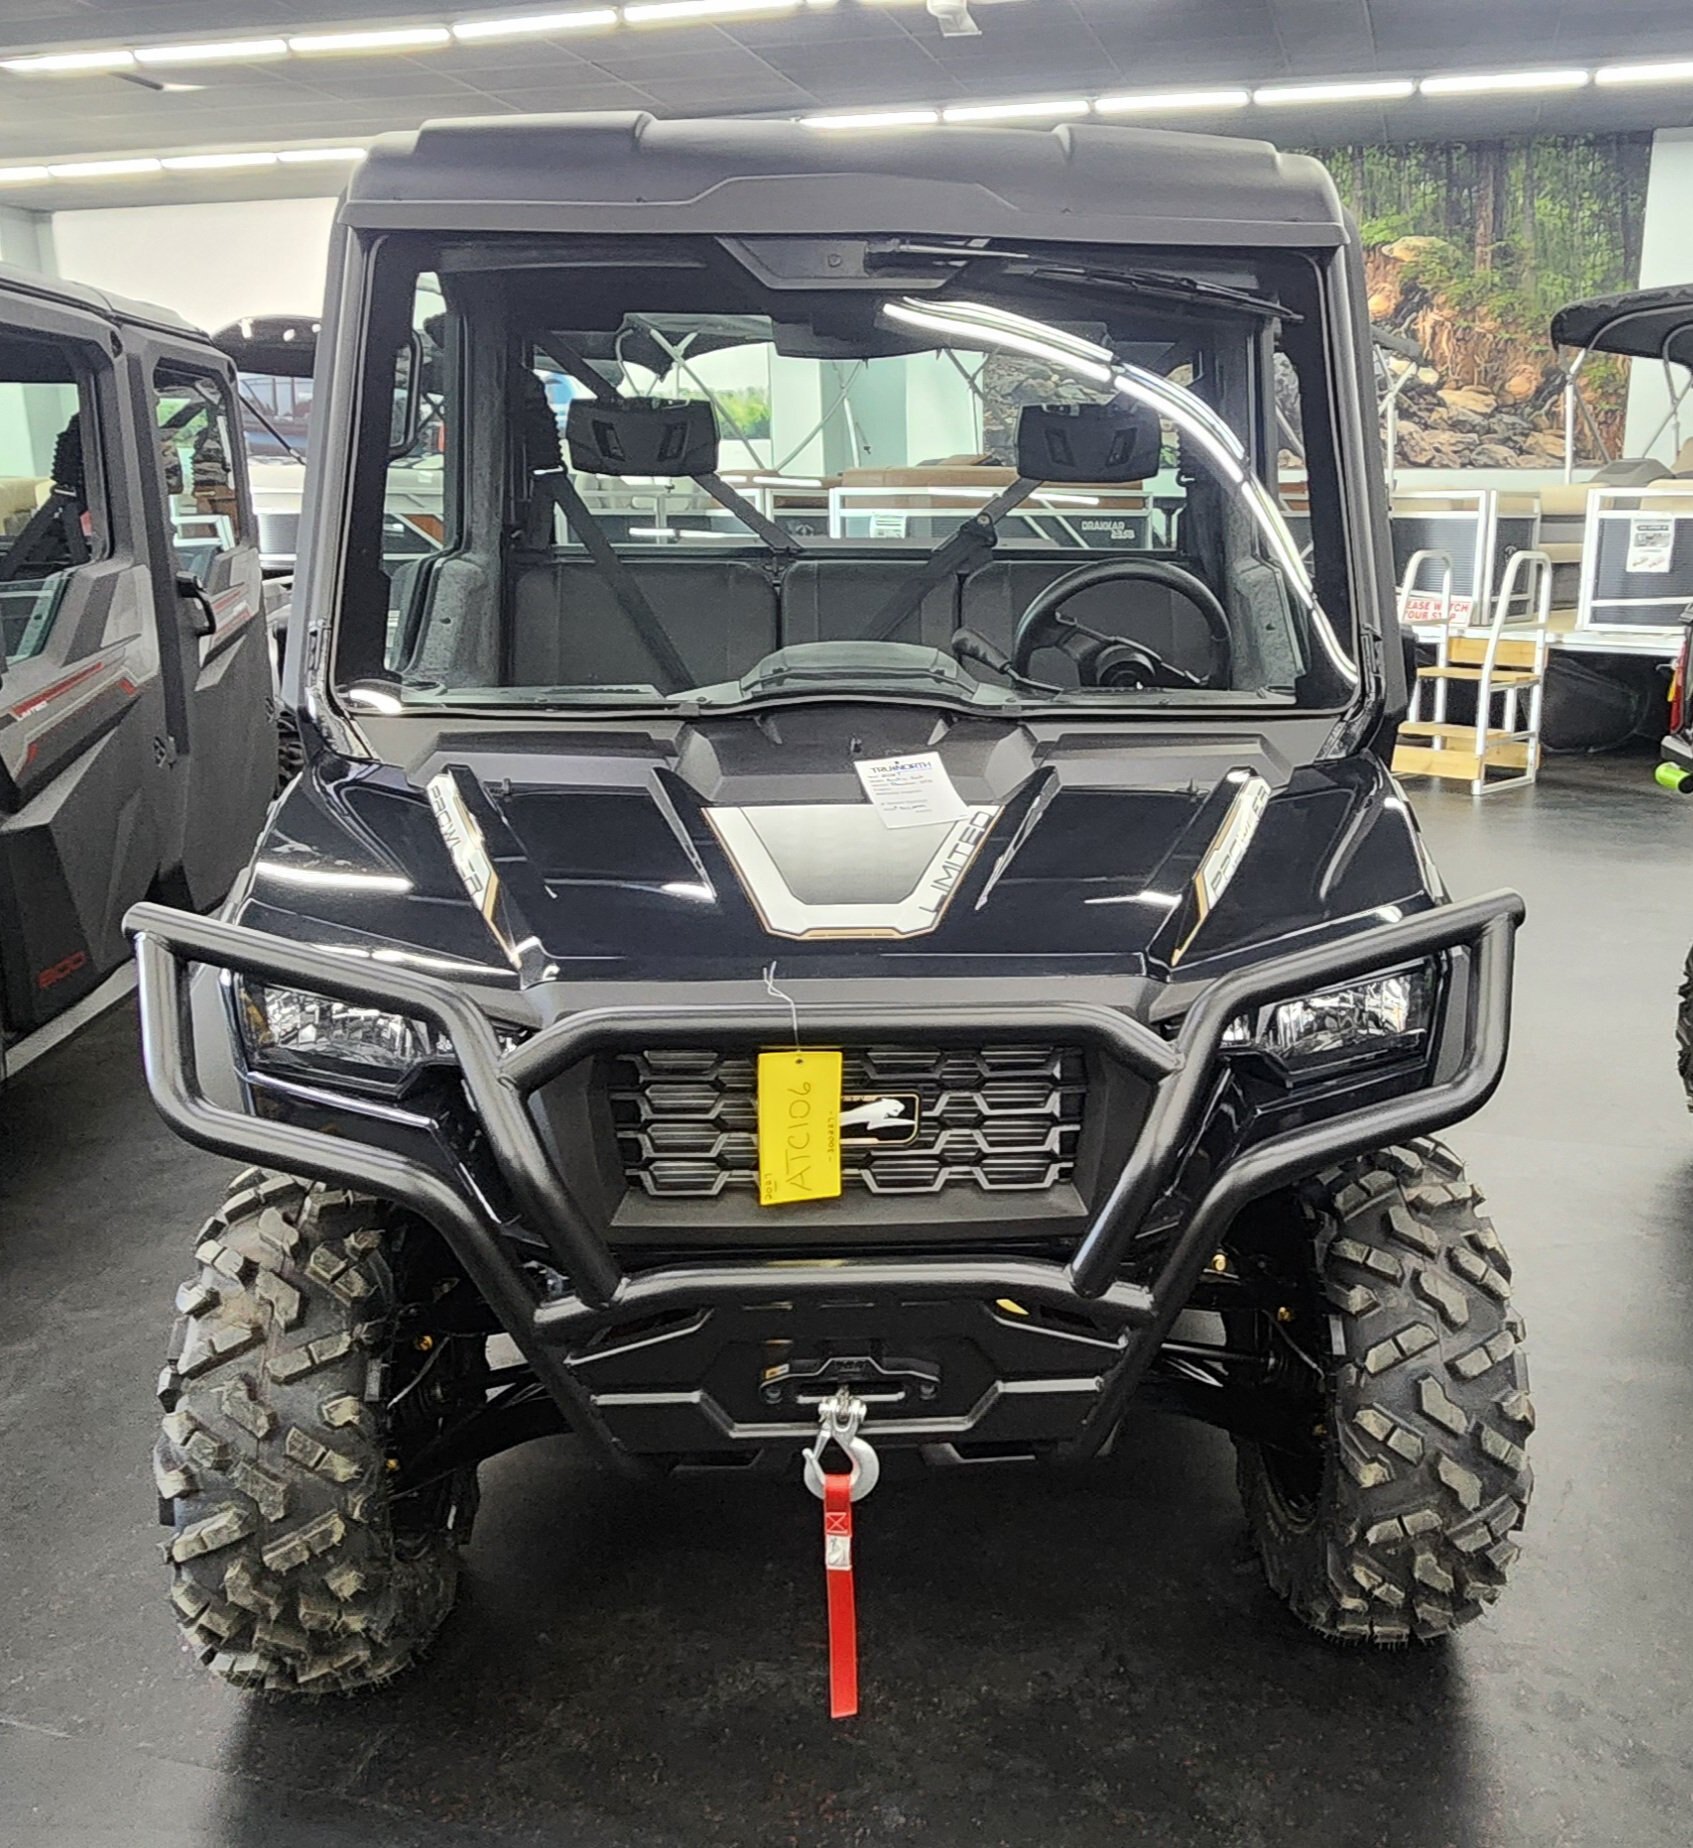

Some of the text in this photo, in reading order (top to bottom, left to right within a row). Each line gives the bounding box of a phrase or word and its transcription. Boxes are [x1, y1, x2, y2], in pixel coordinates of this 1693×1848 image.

[1432, 612, 1456, 620] STP
[1433, 603, 1469, 612] WTCH
[430, 784, 484, 897] PROWER
[918, 810, 994, 913] LIMITED
